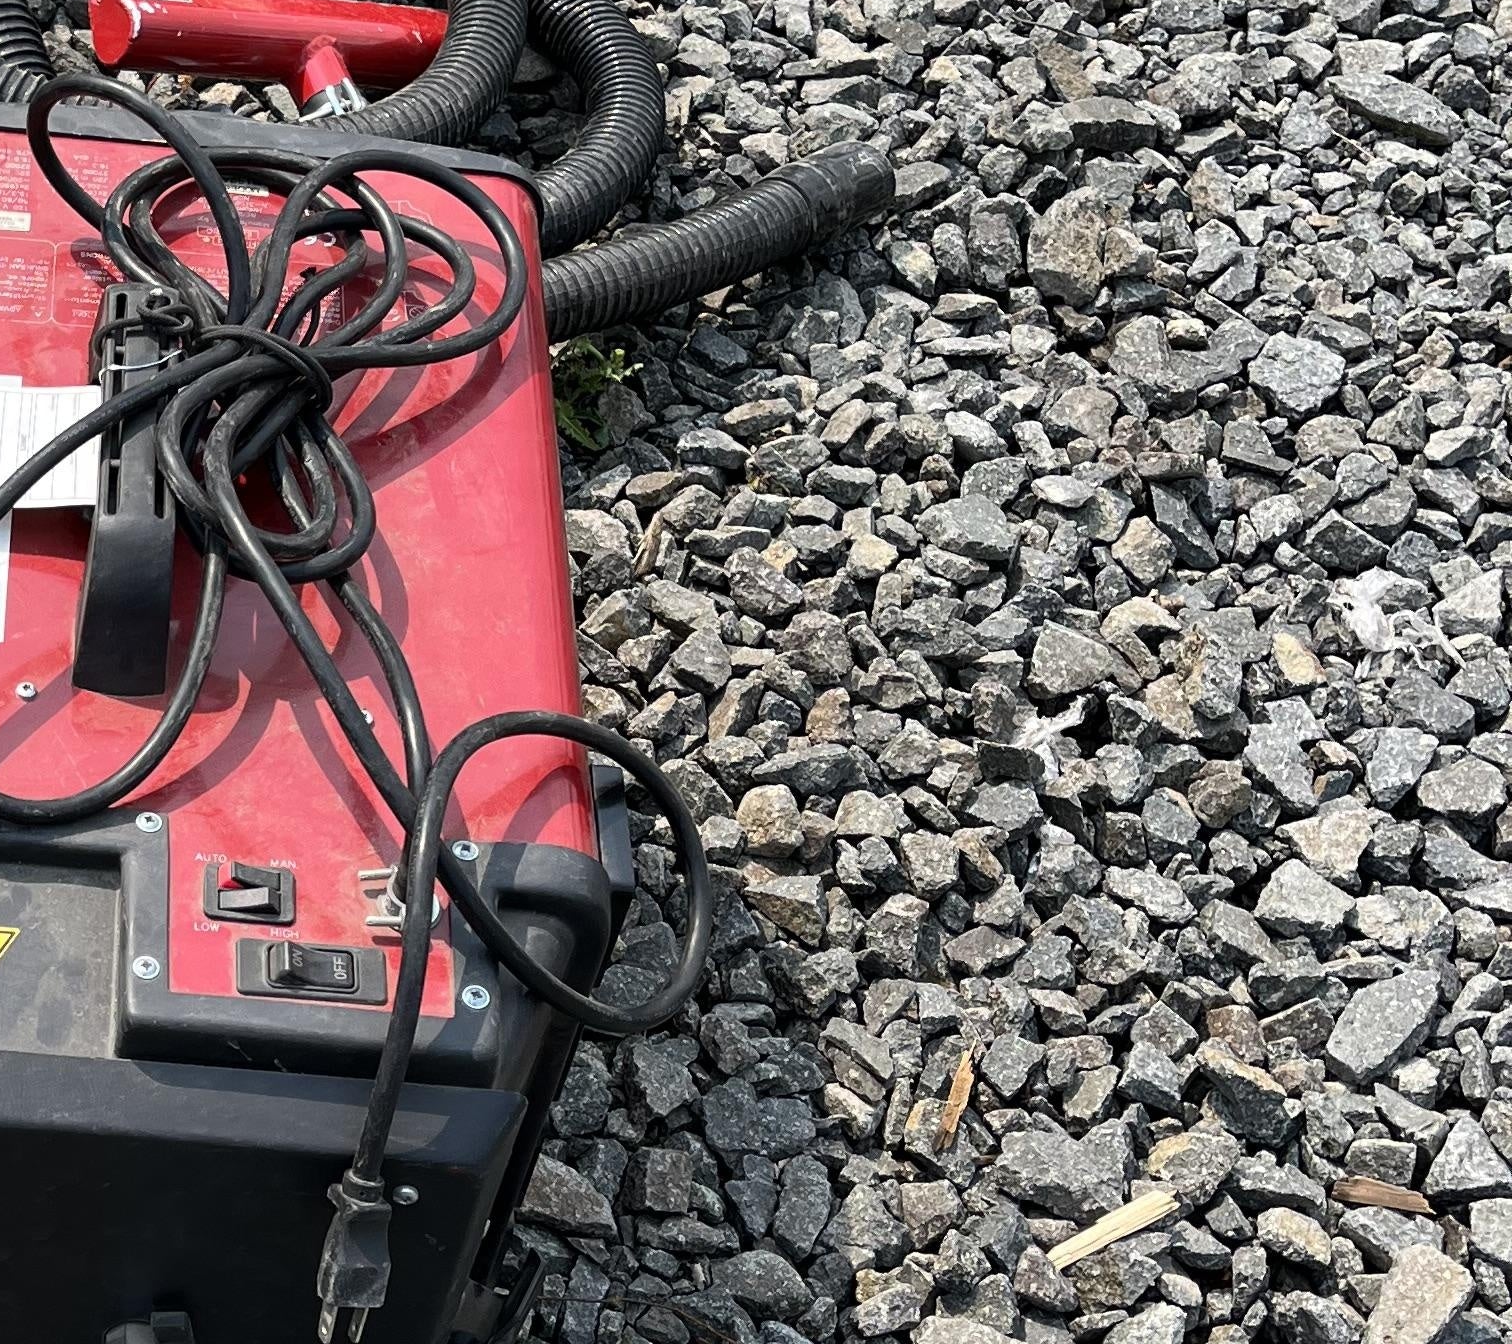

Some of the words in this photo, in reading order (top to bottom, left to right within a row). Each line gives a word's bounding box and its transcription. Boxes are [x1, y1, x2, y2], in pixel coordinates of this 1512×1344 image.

[194, 852, 227, 864] AUTO
[270, 858, 297, 869] MAN
[193, 922, 220, 933] LOW
[270, 928, 299, 939] HIGH
[293, 949, 303, 967] ON
[334, 956, 347, 980] OFF
